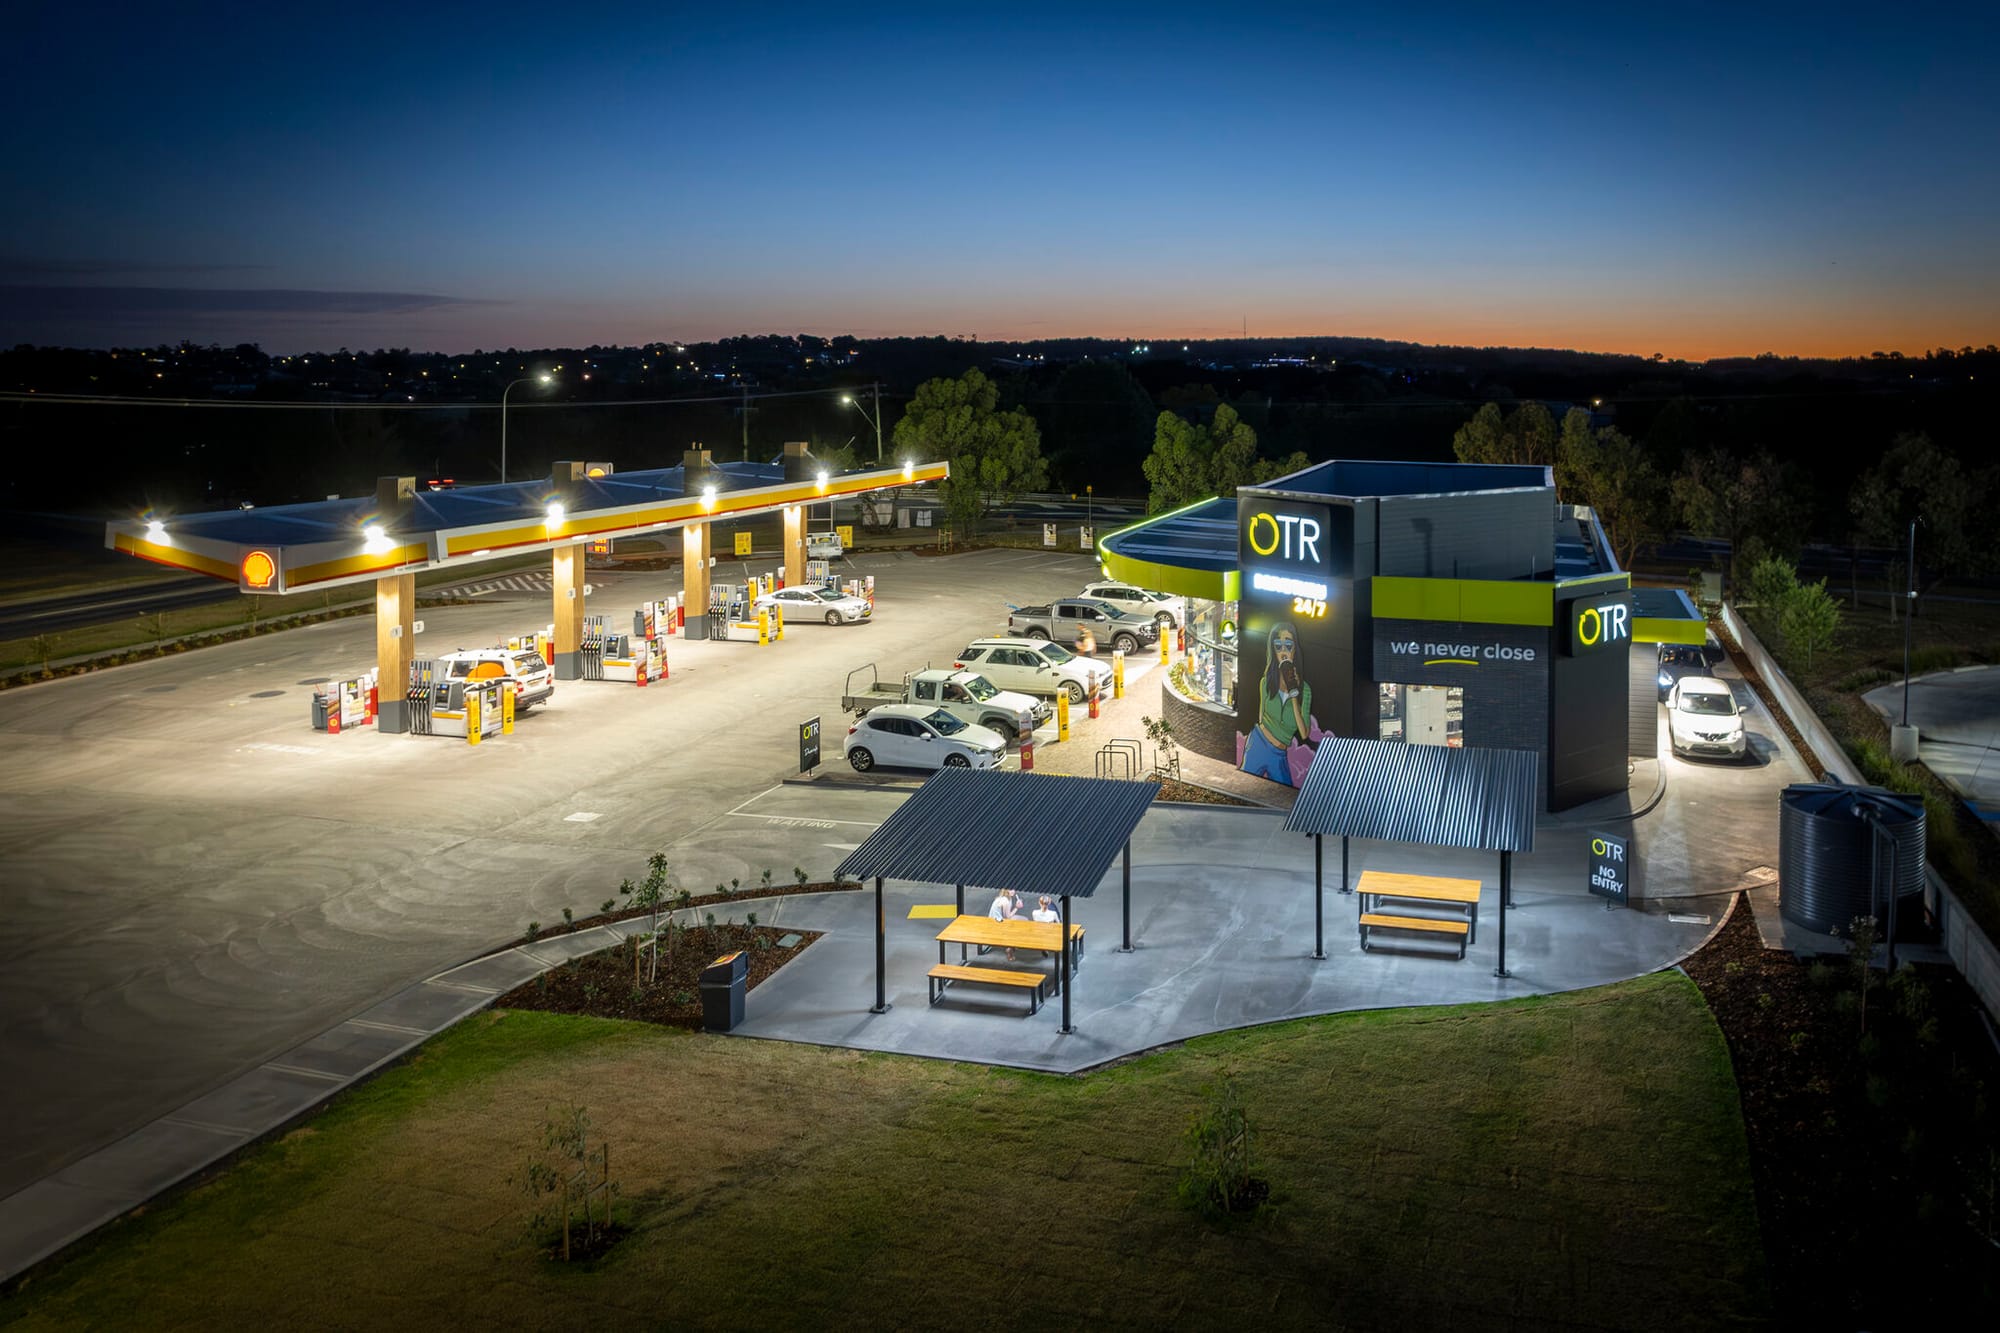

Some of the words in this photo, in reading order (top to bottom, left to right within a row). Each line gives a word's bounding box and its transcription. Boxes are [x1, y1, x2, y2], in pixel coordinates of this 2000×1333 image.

[1249, 512, 1321, 564] OTR
[1293, 597, 1327, 618] 24/7
[1579, 604, 1627, 645] OTR
[1390, 641, 1420, 655] we
[1424, 642, 1480, 658] never
[1483, 643, 1536, 661] close
[803, 722, 819, 740] OTR
[1592, 838, 1624, 862] OTR
[1599, 865, 1616, 879] NO
[1592, 874, 1624, 893] ENTRY
